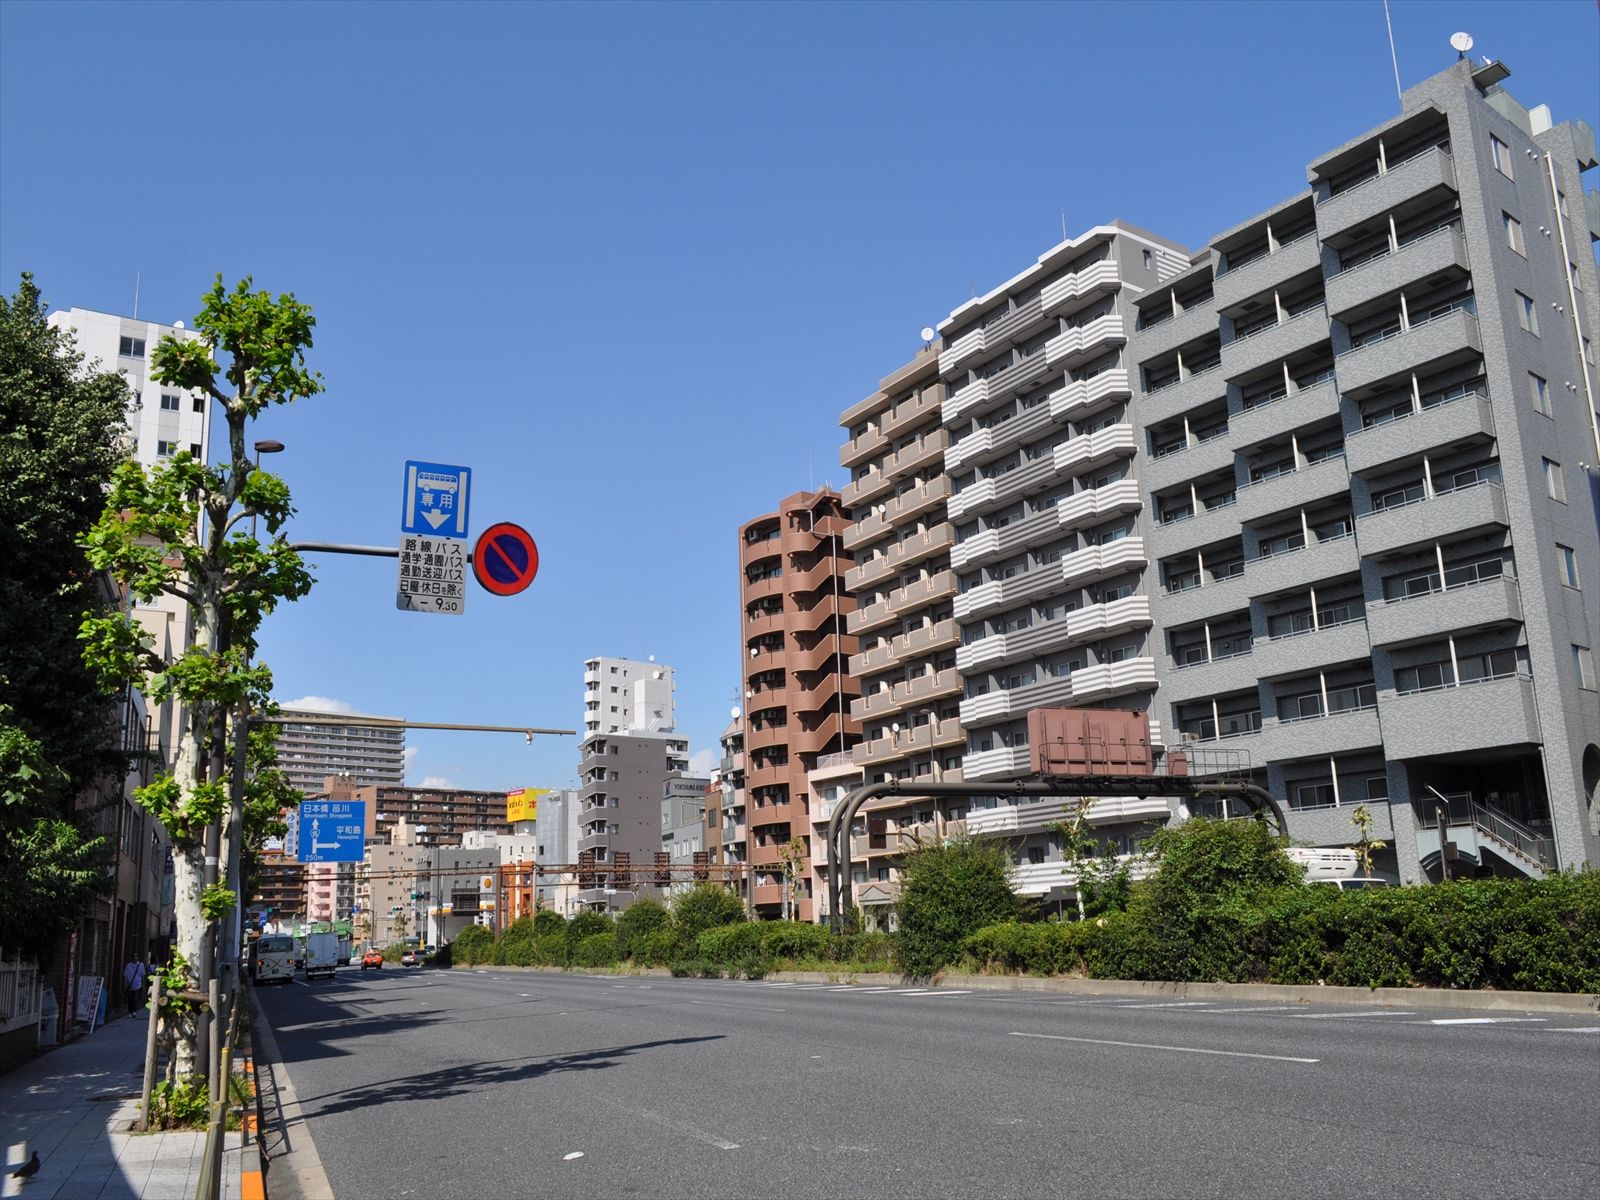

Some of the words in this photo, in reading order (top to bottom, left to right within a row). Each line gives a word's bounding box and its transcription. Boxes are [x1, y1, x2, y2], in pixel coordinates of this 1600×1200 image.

[421, 492, 453, 509] 専用
[405, 539, 461, 555] 路線バス
[400, 564, 463, 581] 通勤送迎バス
[304, 804, 328, 813] 日本橋
[332, 804, 350, 813] 品川
[336, 826, 361, 834] 平和島
